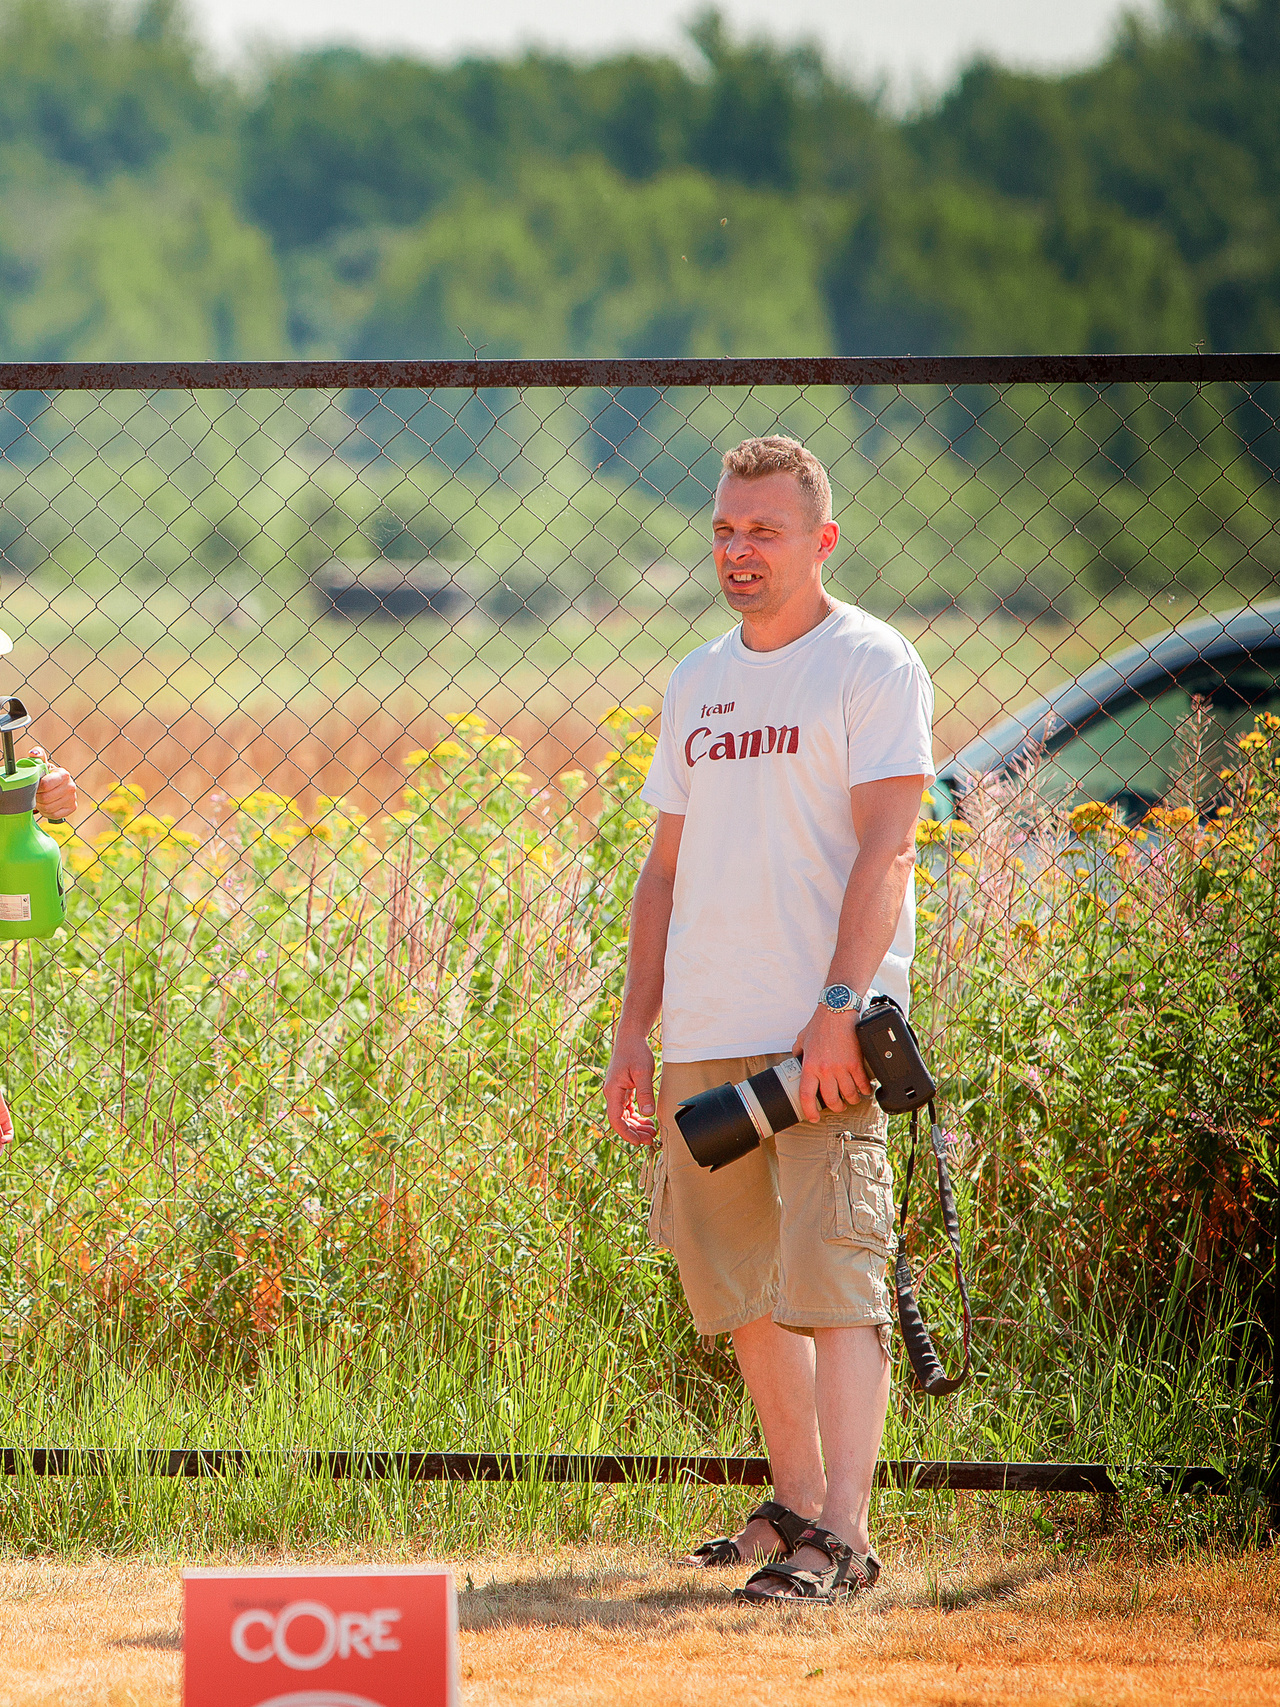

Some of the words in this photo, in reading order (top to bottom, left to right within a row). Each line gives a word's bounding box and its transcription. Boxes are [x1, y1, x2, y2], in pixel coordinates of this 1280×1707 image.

[700, 701, 735, 719] team
[684, 724, 800, 768] Canon
[230, 1599, 403, 1672] CORE
